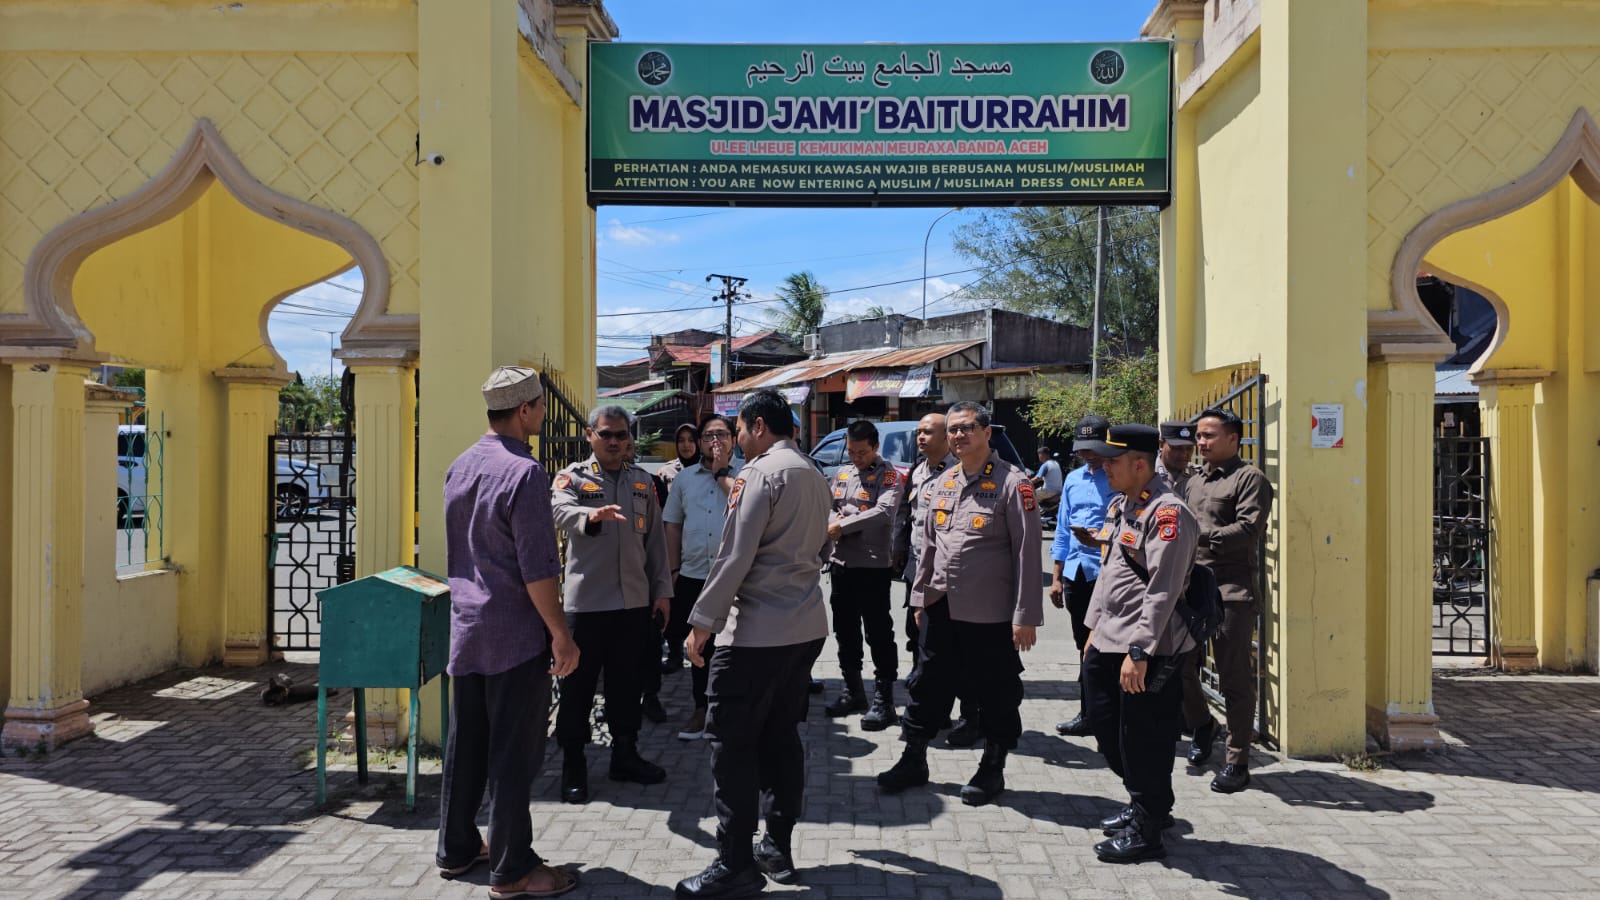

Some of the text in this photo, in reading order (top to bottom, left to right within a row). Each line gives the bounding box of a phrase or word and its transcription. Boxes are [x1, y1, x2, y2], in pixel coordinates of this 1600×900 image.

[747, 51, 1011, 87] مسجد الجامع بيت الرحيم
[632, 99, 765, 129] MASJID
[877, 98, 1127, 130] BAITURRAHIM
[710, 140, 1048, 155] ULEE LHEUE KEMUKIMAN MEURAXA BANDA ACEH
[613, 163, 689, 173] PERHATIAN
[699, 164, 738, 174] ANDA
[741, 164, 811, 175] MEMASUKI
[814, 164, 881, 175] KAWASAN
[885, 164, 929, 174] WAJIB
[931, 163, 1013, 174] BERBUSANA
[1016, 162, 1145, 174] MUSLIM/MUSLIMAH
[615, 177, 689, 187] ATTENTION
[699, 178, 727, 188] YOU
[730, 178, 756, 188] ARE
[762, 178, 796, 189] NOW
[799, 179, 864, 189] ENTERING
[867, 179, 877, 189] A
[880, 179, 932, 189] MUSLIM
[943, 178, 1015, 188] MUSLIMAH
[1021, 178, 1064, 188] DRESS
[1070, 177, 1105, 187] ONLY
[1108, 177, 1145, 187] AREA
